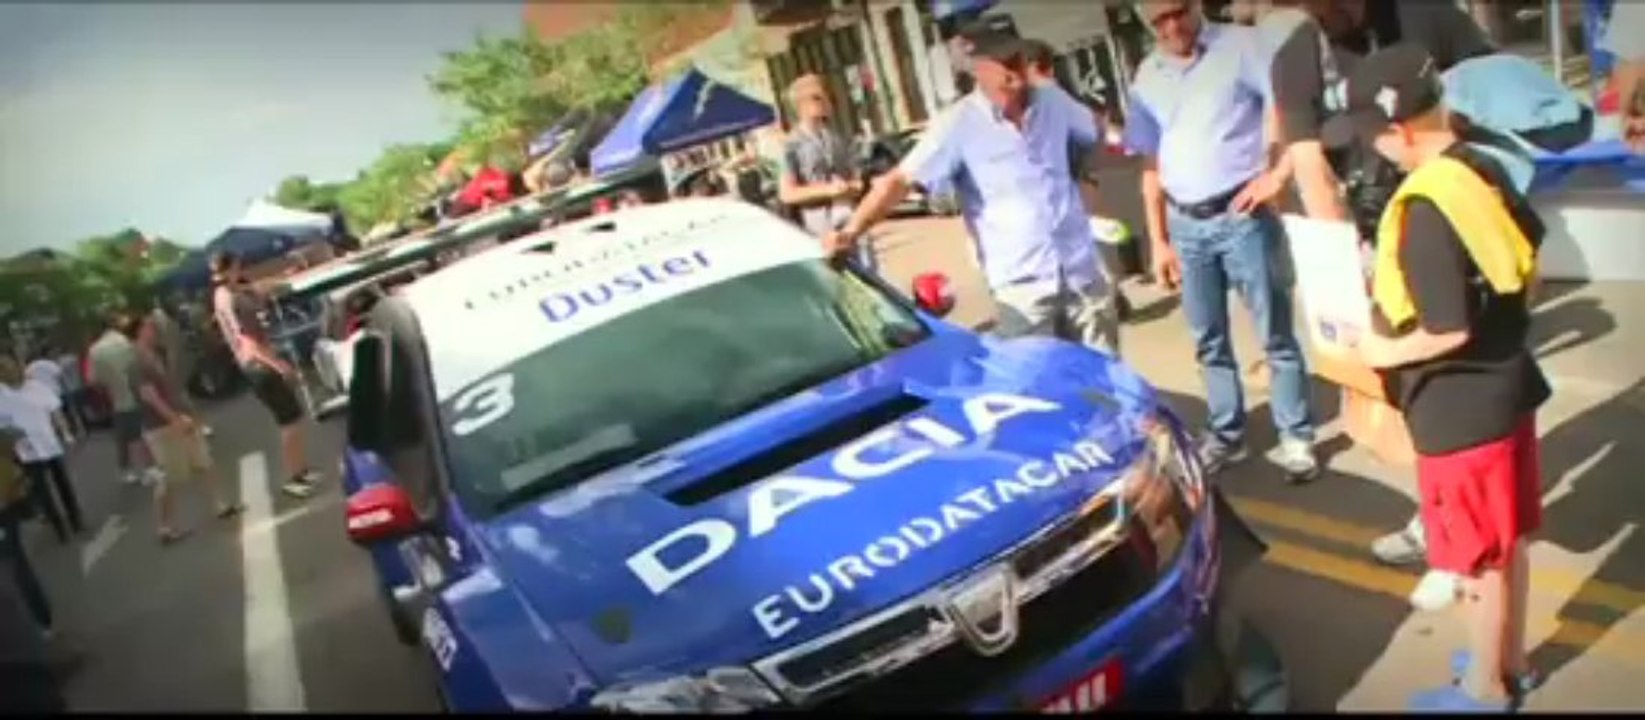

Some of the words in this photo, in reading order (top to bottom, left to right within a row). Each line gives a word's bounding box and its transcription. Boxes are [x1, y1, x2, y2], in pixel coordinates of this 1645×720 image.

[538, 250, 712, 323] Duster
[452, 372, 515, 437] 3
[626, 391, 1064, 596] DACIA
[752, 439, 1115, 640] EURODATACAR
